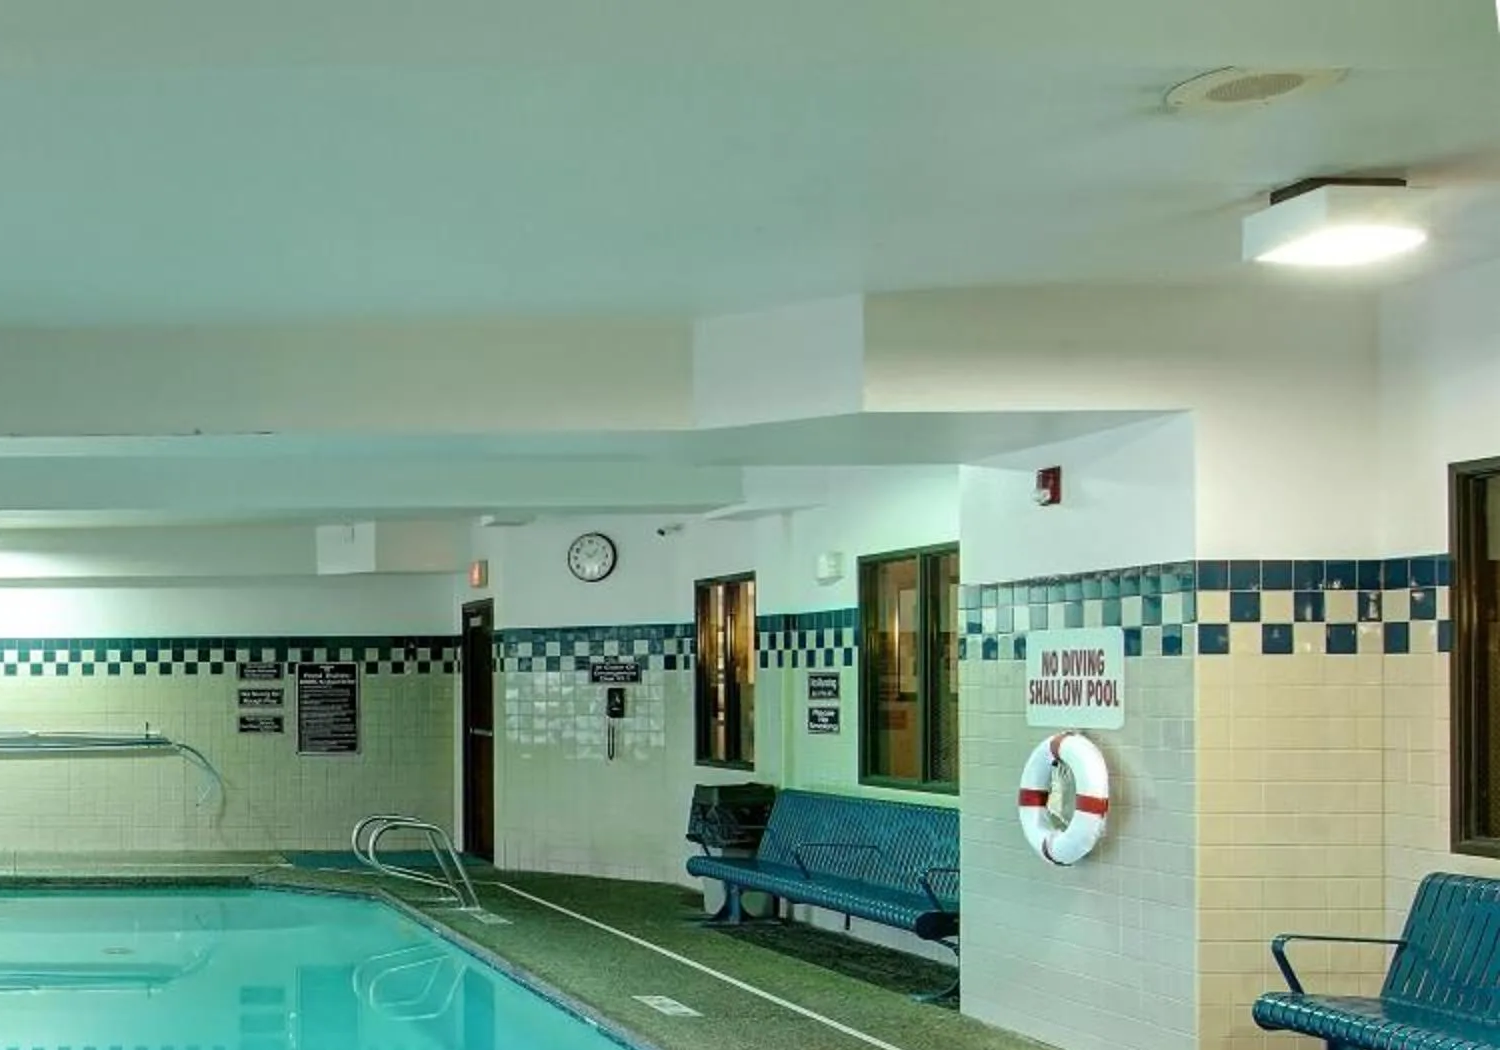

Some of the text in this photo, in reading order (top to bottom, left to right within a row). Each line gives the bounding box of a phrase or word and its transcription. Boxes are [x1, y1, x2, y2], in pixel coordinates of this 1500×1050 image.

[1041, 648, 1105, 677] NO DIVING
[1029, 679, 1119, 707] SHALLOW POOL
